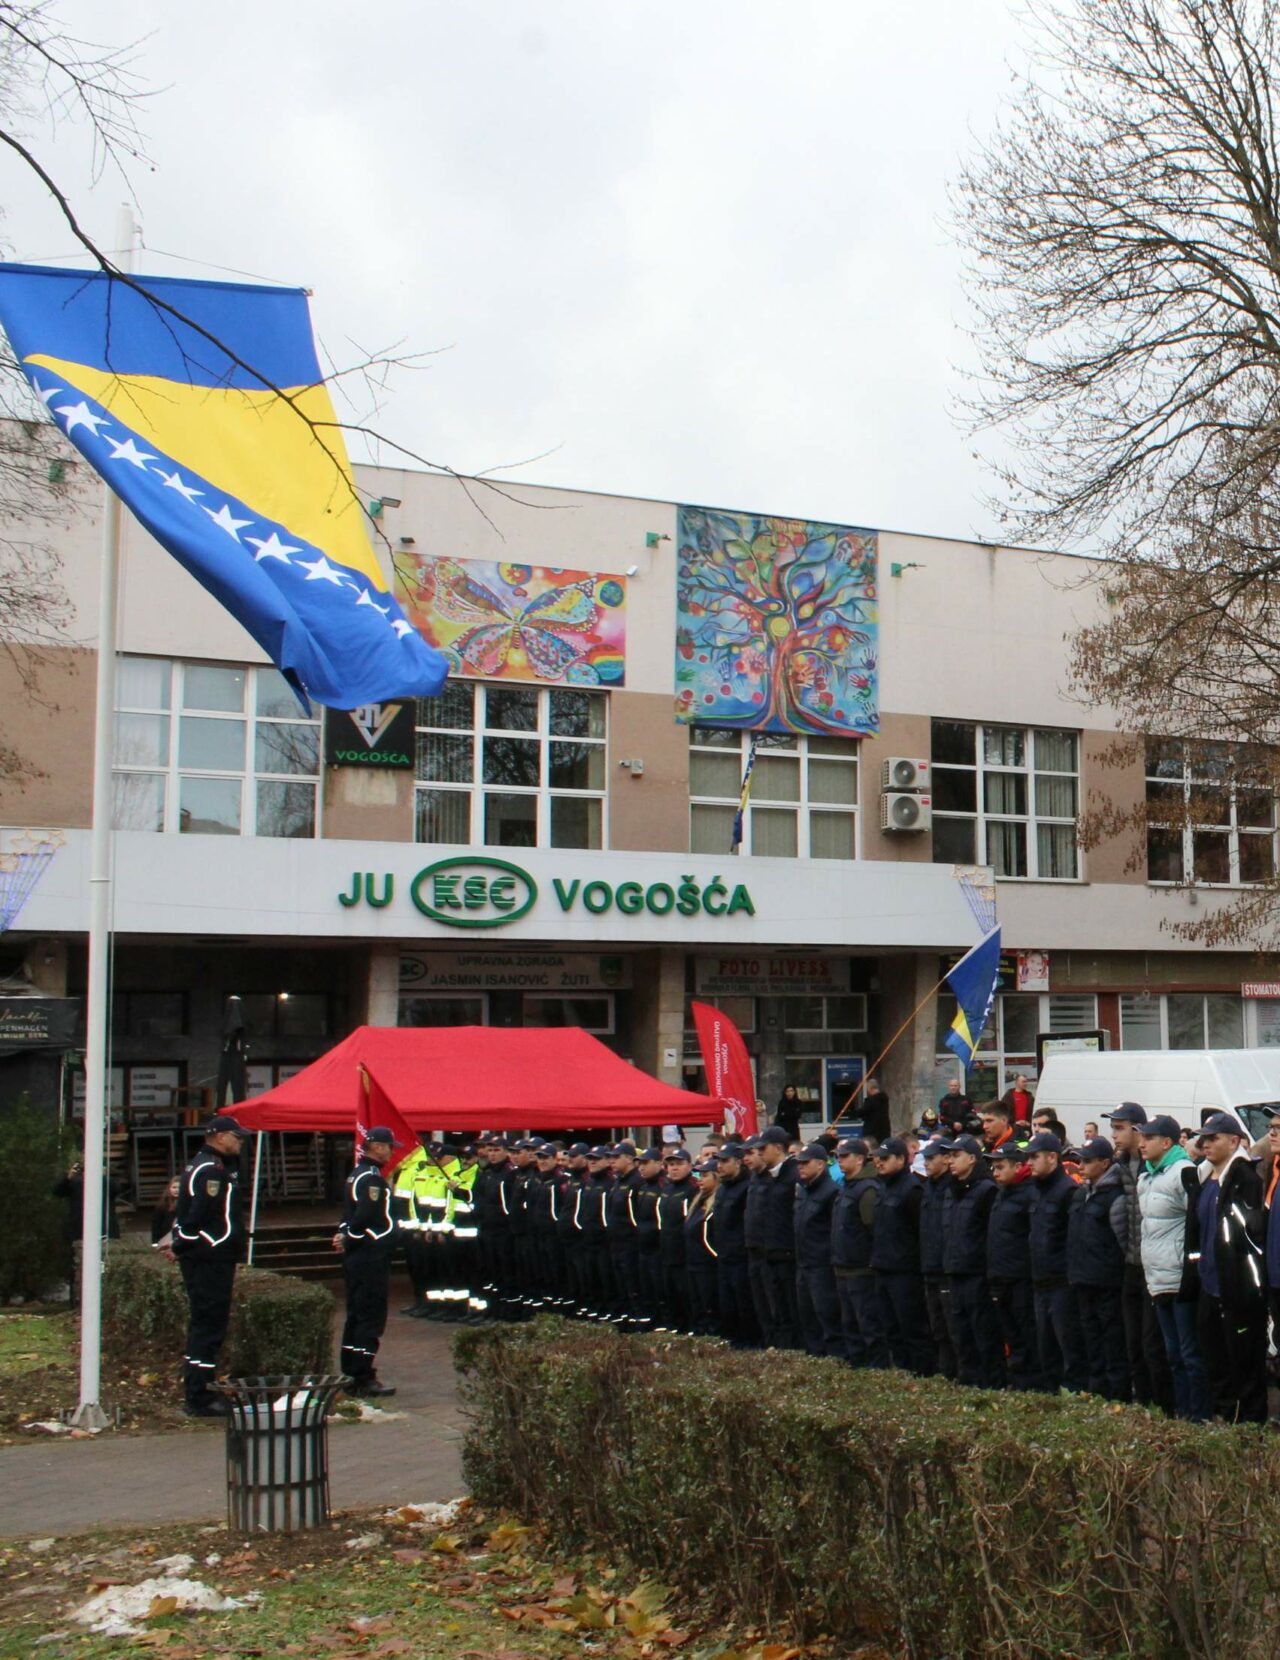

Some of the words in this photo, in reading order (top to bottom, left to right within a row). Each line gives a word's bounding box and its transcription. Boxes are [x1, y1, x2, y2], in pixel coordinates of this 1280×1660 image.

[338, 872, 394, 908] JU
[433, 873, 517, 910] KSC
[552, 874, 757, 917] VOGOŠĆA
[458, 956, 513, 967] UPRAVNA
[516, 957, 564, 967] ZGRADA
[719, 960, 760, 975] FOTO
[400, 963, 419, 975] SC
[430, 974, 481, 985] JASMIN
[485, 972, 549, 985] ISANOVIĆ
[560, 971, 590, 985] ŽUTI
